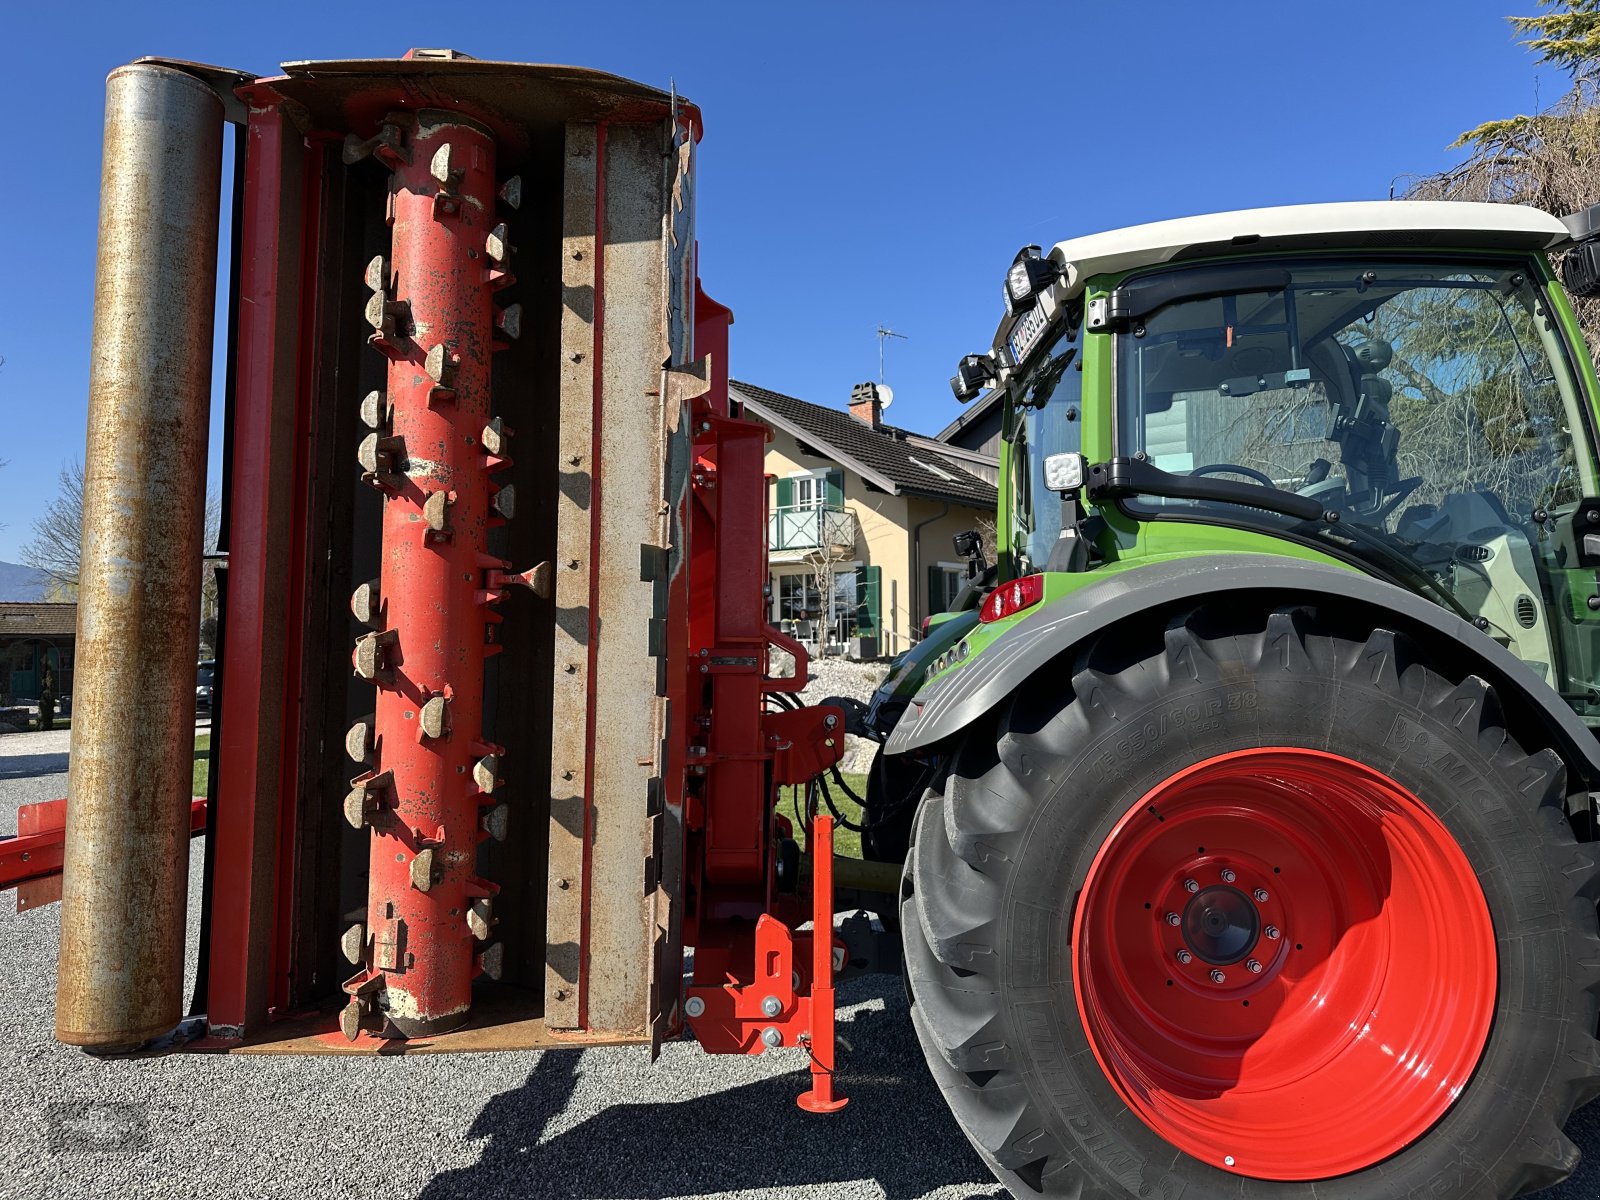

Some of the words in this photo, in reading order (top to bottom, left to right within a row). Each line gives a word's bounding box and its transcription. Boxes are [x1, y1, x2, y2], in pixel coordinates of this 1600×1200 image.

[1205, 698, 1224, 718] R
[1227, 688, 1257, 711] 38
[1434, 752, 1547, 908] MICHELIN
[1022, 1006, 1135, 1178] MICHELIN
